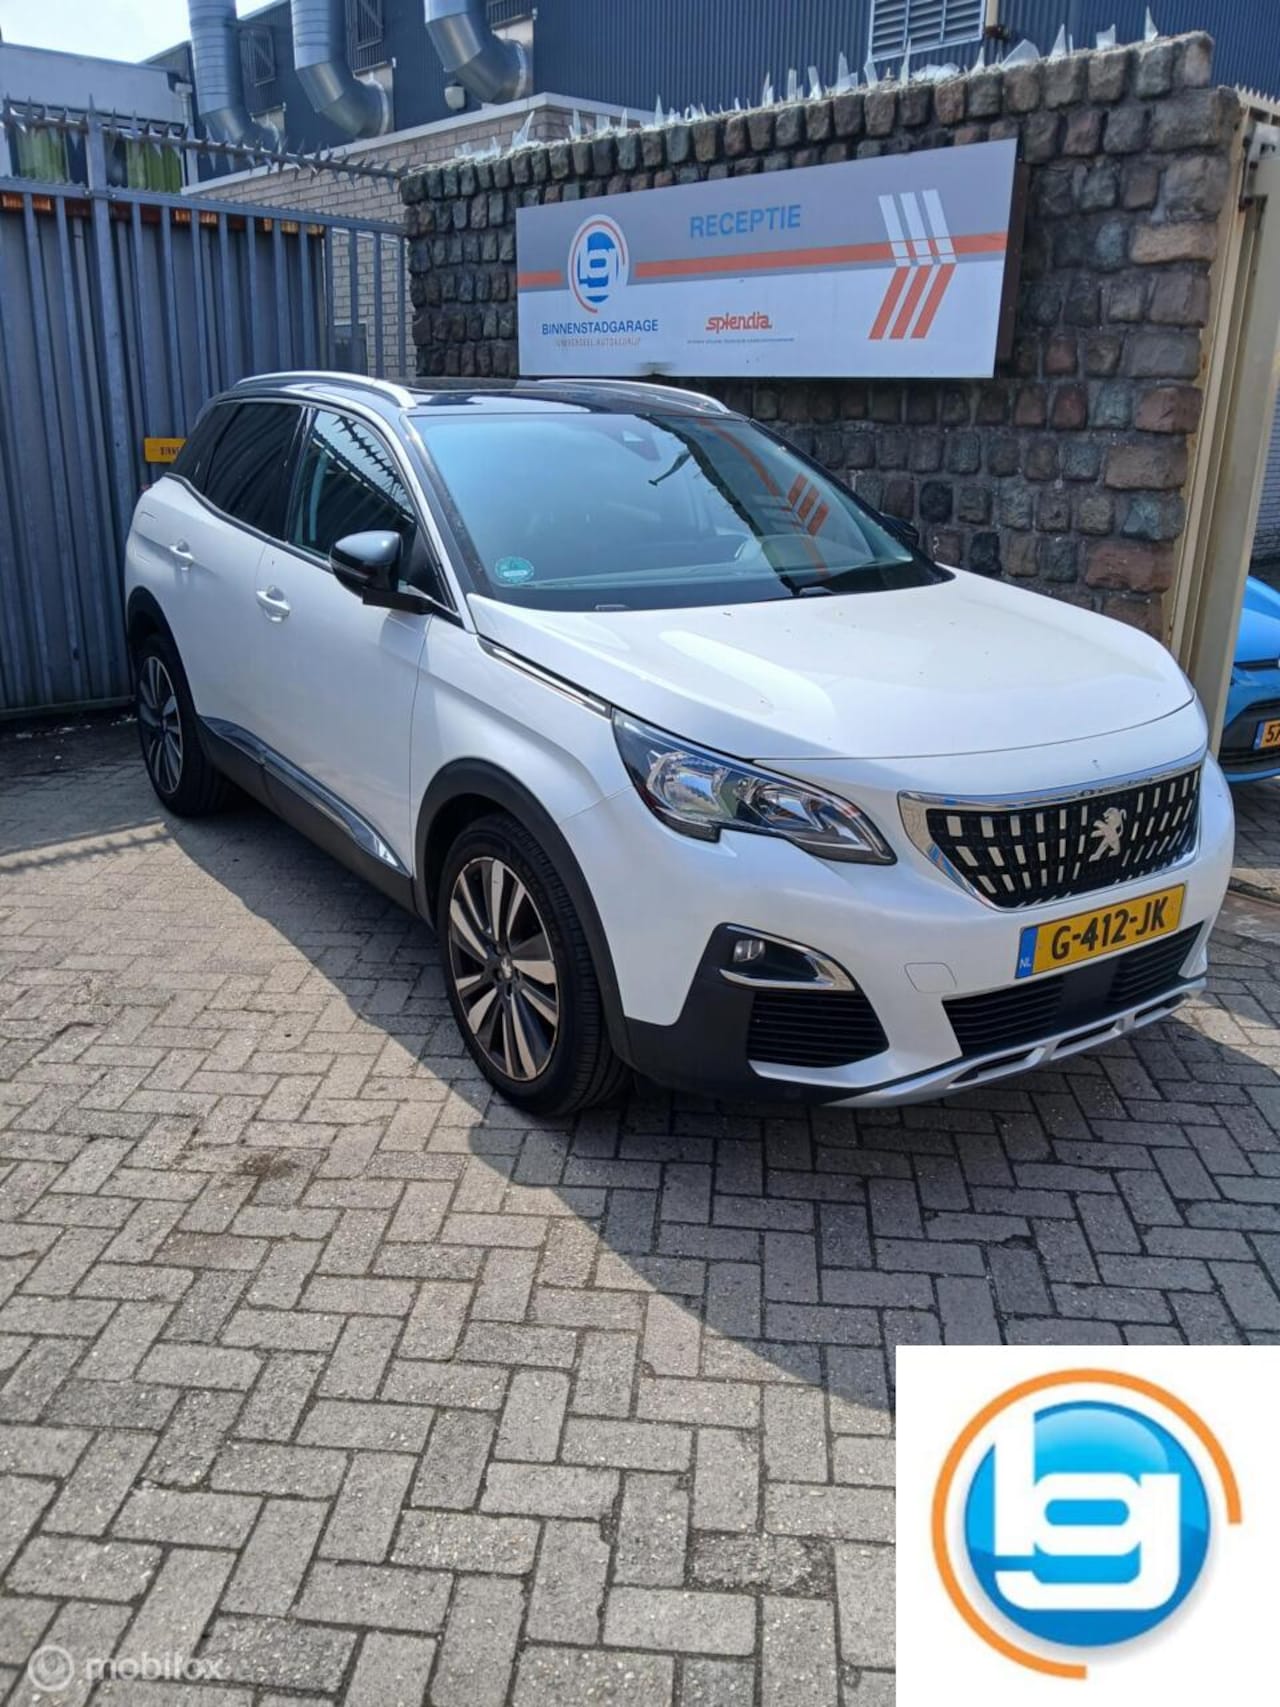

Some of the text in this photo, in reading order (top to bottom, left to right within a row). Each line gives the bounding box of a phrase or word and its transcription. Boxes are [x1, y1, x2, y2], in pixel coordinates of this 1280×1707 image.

[689, 204, 801, 239] RECEPTIE
[541, 319, 660, 336] BINNENSTADGARAGE
[1051, 896, 1168, 961] G-412-JK
[1019, 957, 1032, 969] NL
